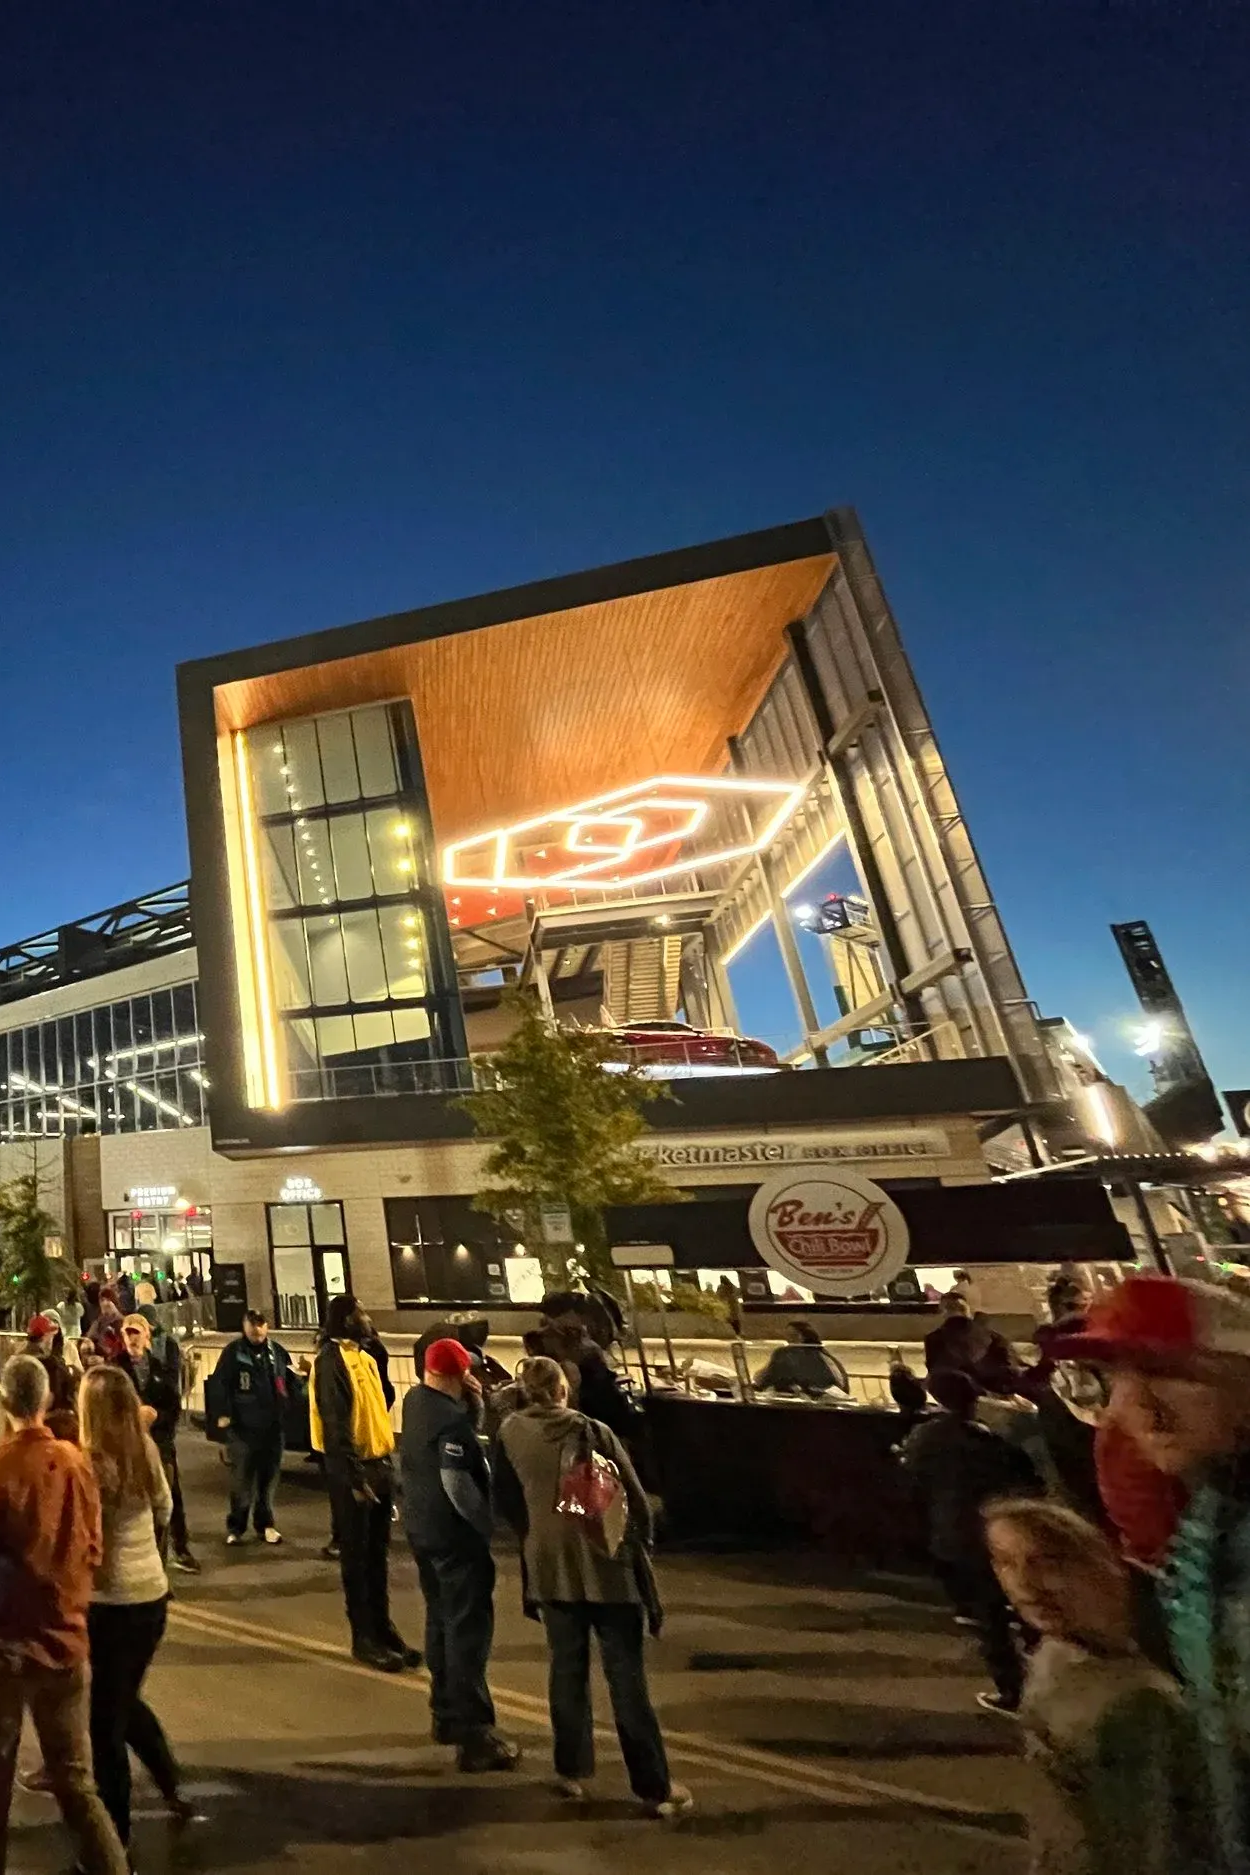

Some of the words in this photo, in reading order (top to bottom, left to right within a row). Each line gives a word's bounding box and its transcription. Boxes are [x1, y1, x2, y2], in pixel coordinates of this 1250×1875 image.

[286, 1178, 313, 1189] BOX
[280, 1188, 322, 1200] OFFICE
[770, 1199, 855, 1227] Ben's
[788, 1237, 826, 1254] Chili
[828, 1236, 872, 1254] Bowl
